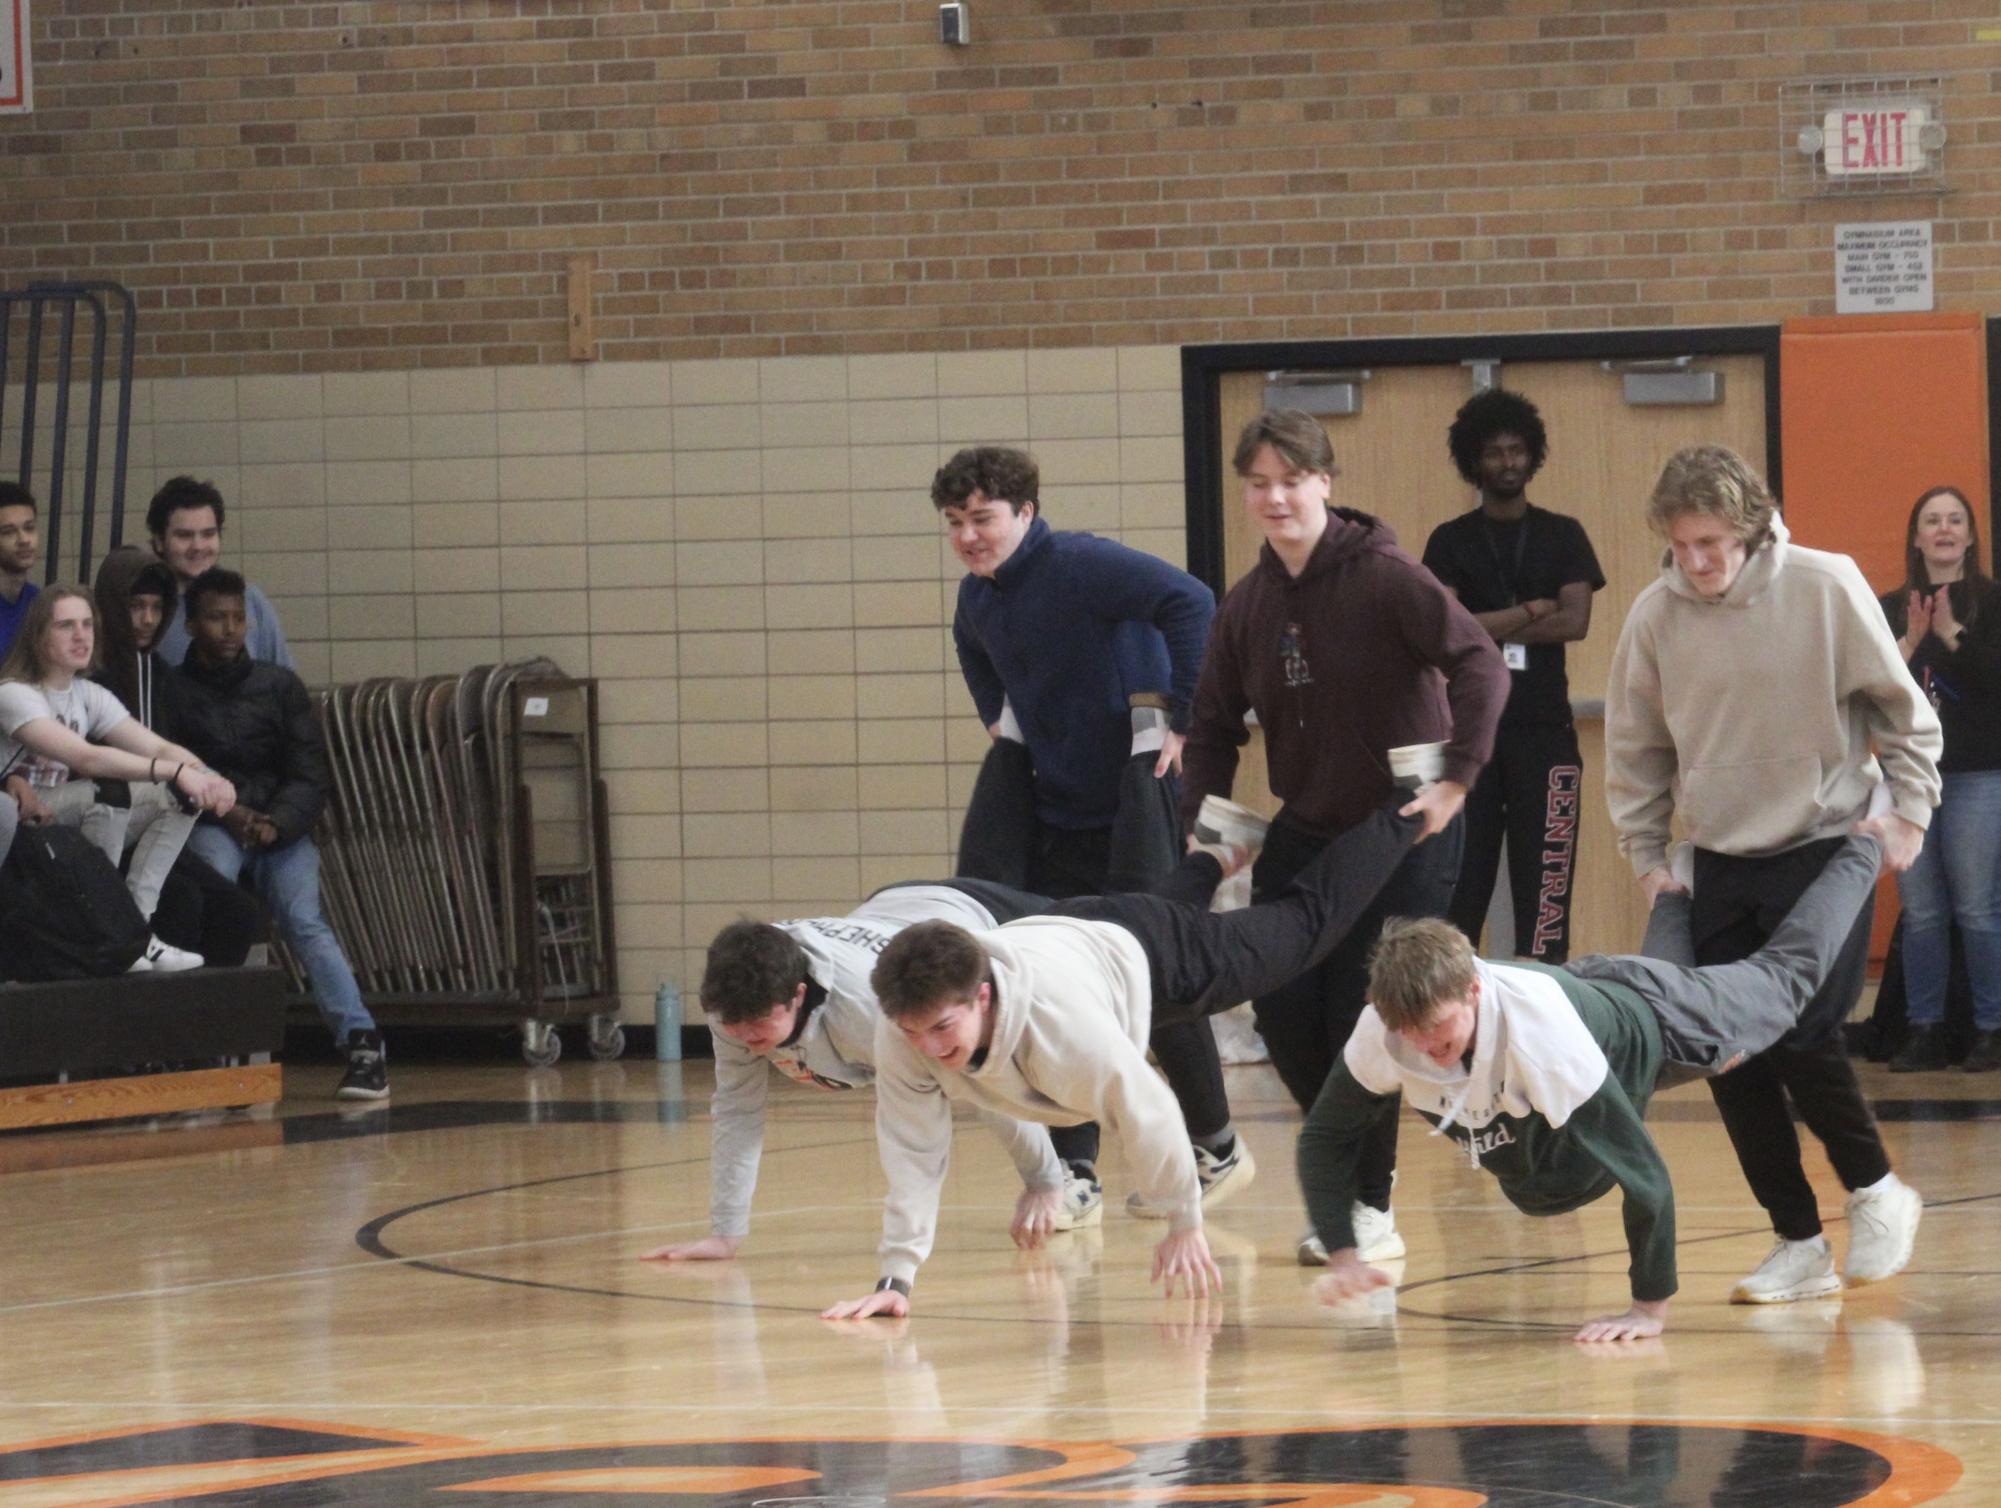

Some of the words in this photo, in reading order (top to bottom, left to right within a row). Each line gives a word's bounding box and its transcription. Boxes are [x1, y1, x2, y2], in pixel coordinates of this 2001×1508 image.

[1841, 112, 1906, 168] EXIT
[1899, 228, 1920, 237] AREA
[1532, 765, 1580, 955] CENTRAL
